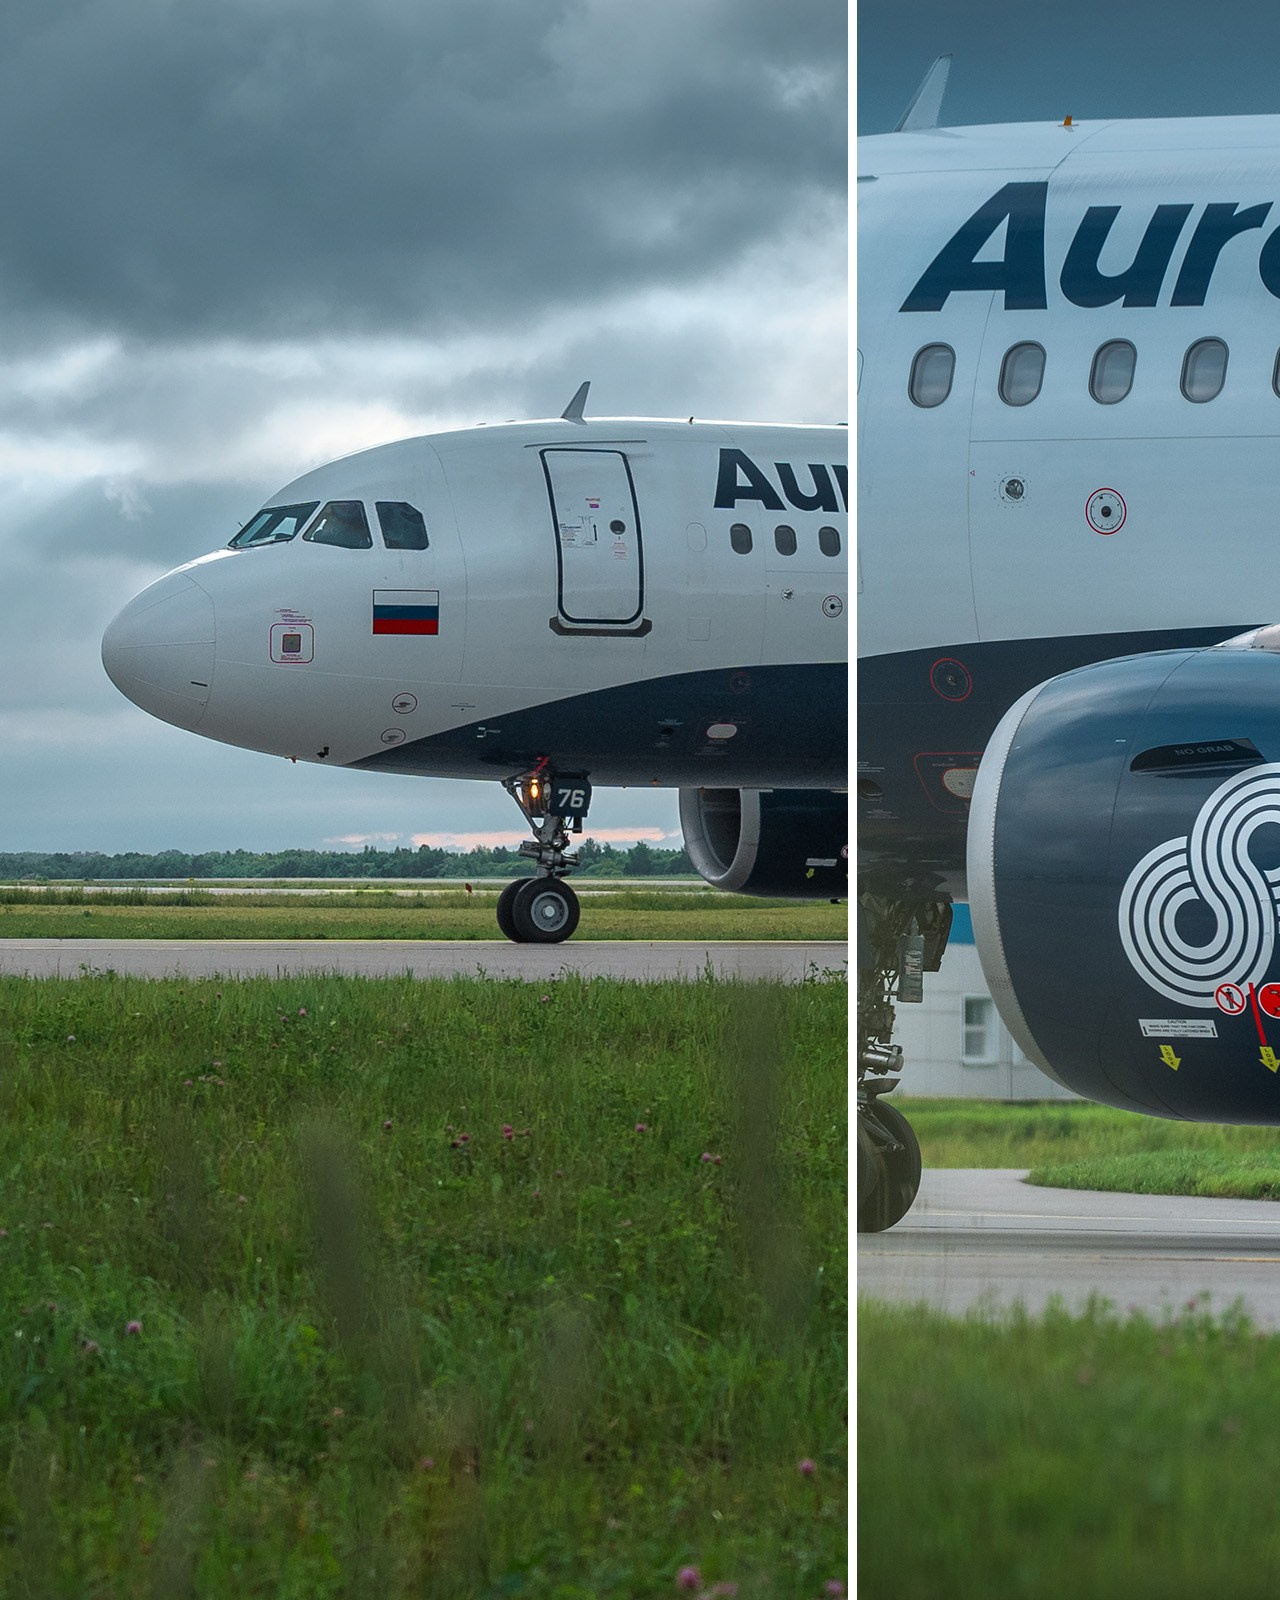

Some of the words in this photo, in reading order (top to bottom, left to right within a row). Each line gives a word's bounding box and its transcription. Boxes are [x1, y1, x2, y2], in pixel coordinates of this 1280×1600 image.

[1174, 748, 1194, 756] NO
[1197, 744, 1234, 754] GRAB
[558, 788, 585, 808] 76
[1163, 1046, 1176, 1066] LOOK
[1264, 1048, 1275, 1068] LOOK
